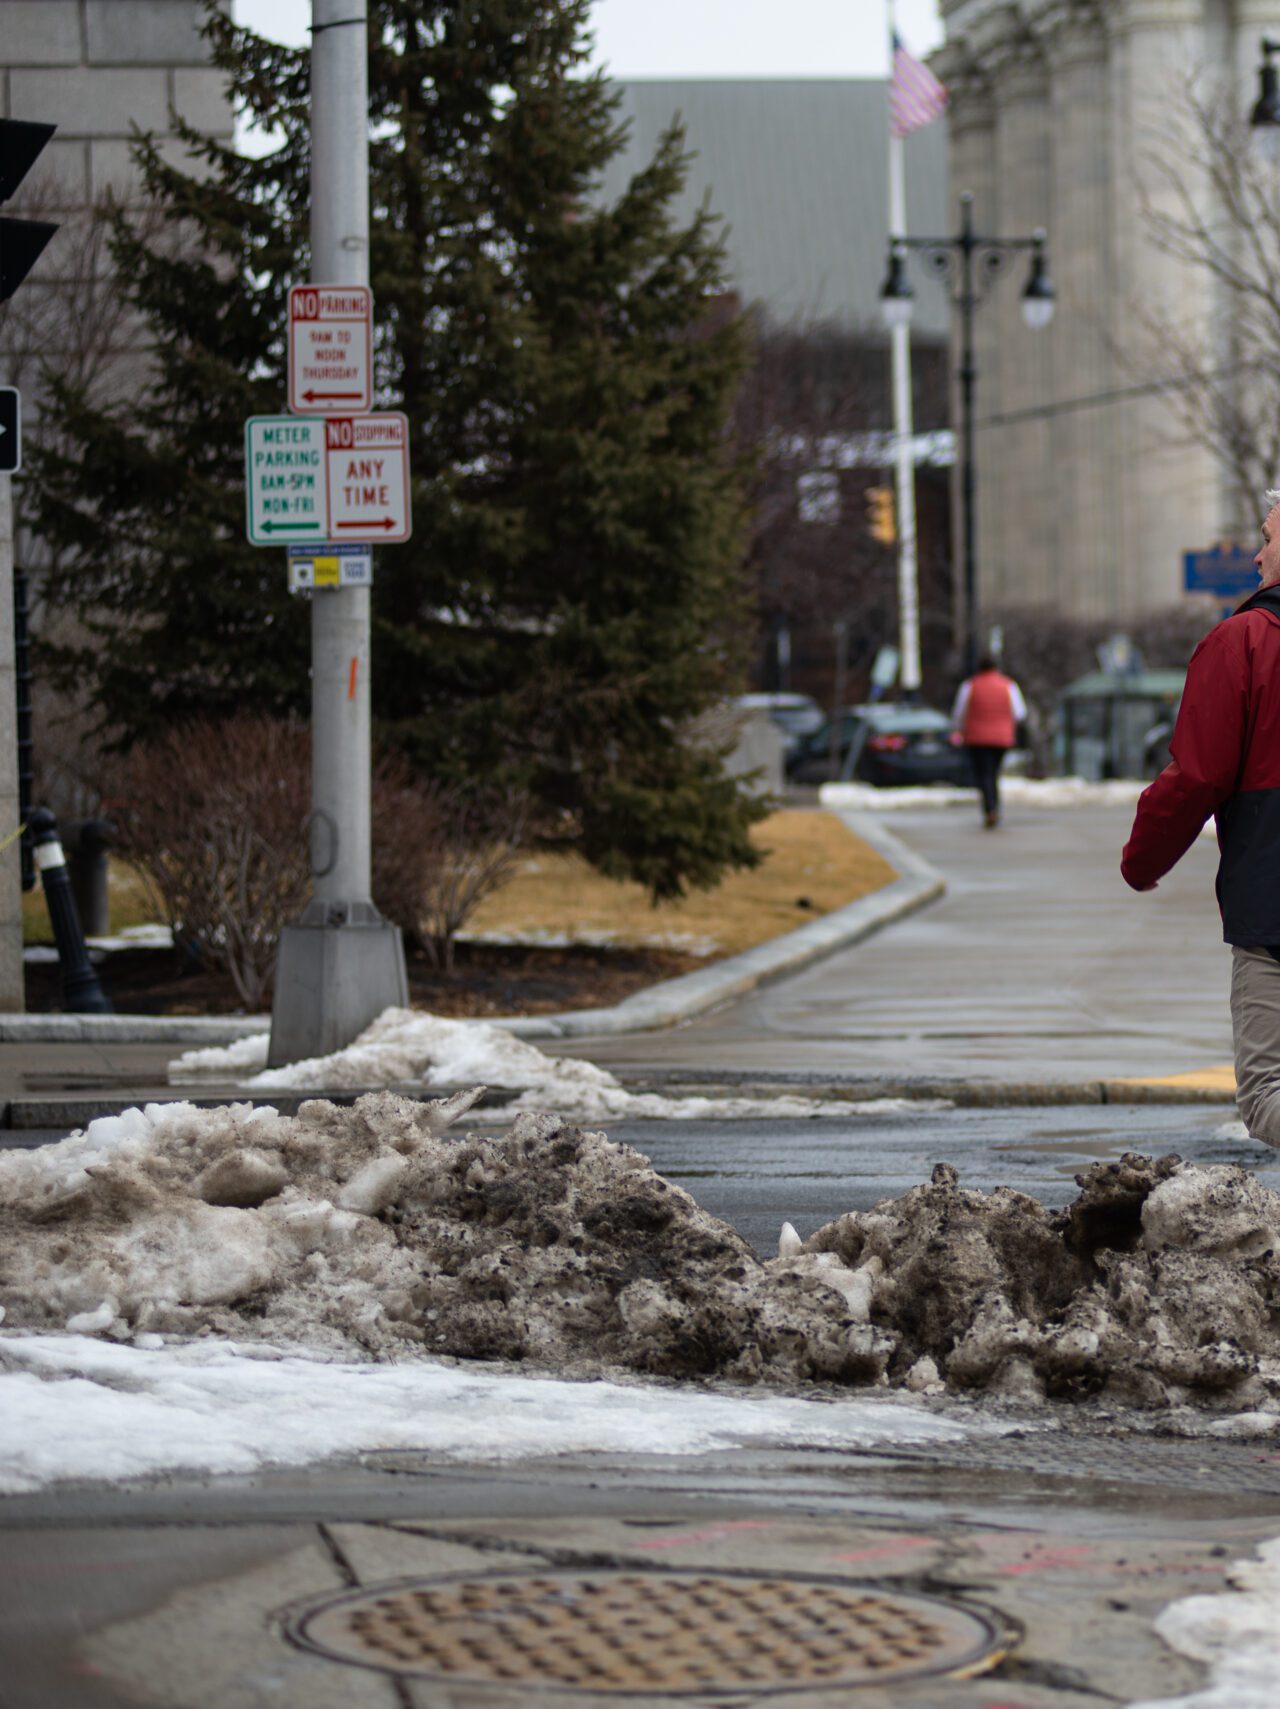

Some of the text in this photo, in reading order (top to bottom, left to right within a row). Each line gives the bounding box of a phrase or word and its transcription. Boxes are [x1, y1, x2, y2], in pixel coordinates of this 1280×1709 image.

[293, 294, 367, 318] NO PARKING
[310, 330, 352, 344] 9AM TO
[315, 349, 346, 361] NOON
[303, 366, 359, 380] THURSDAY
[263, 427, 311, 444] METER
[328, 421, 402, 447] NO STOPPING
[255, 450, 320, 468] PARKING
[346, 458, 385, 480] ANY
[261, 473, 315, 491] 8AM-5PM
[263, 496, 315, 514] MON-FRI
[343, 485, 390, 507] TIME
